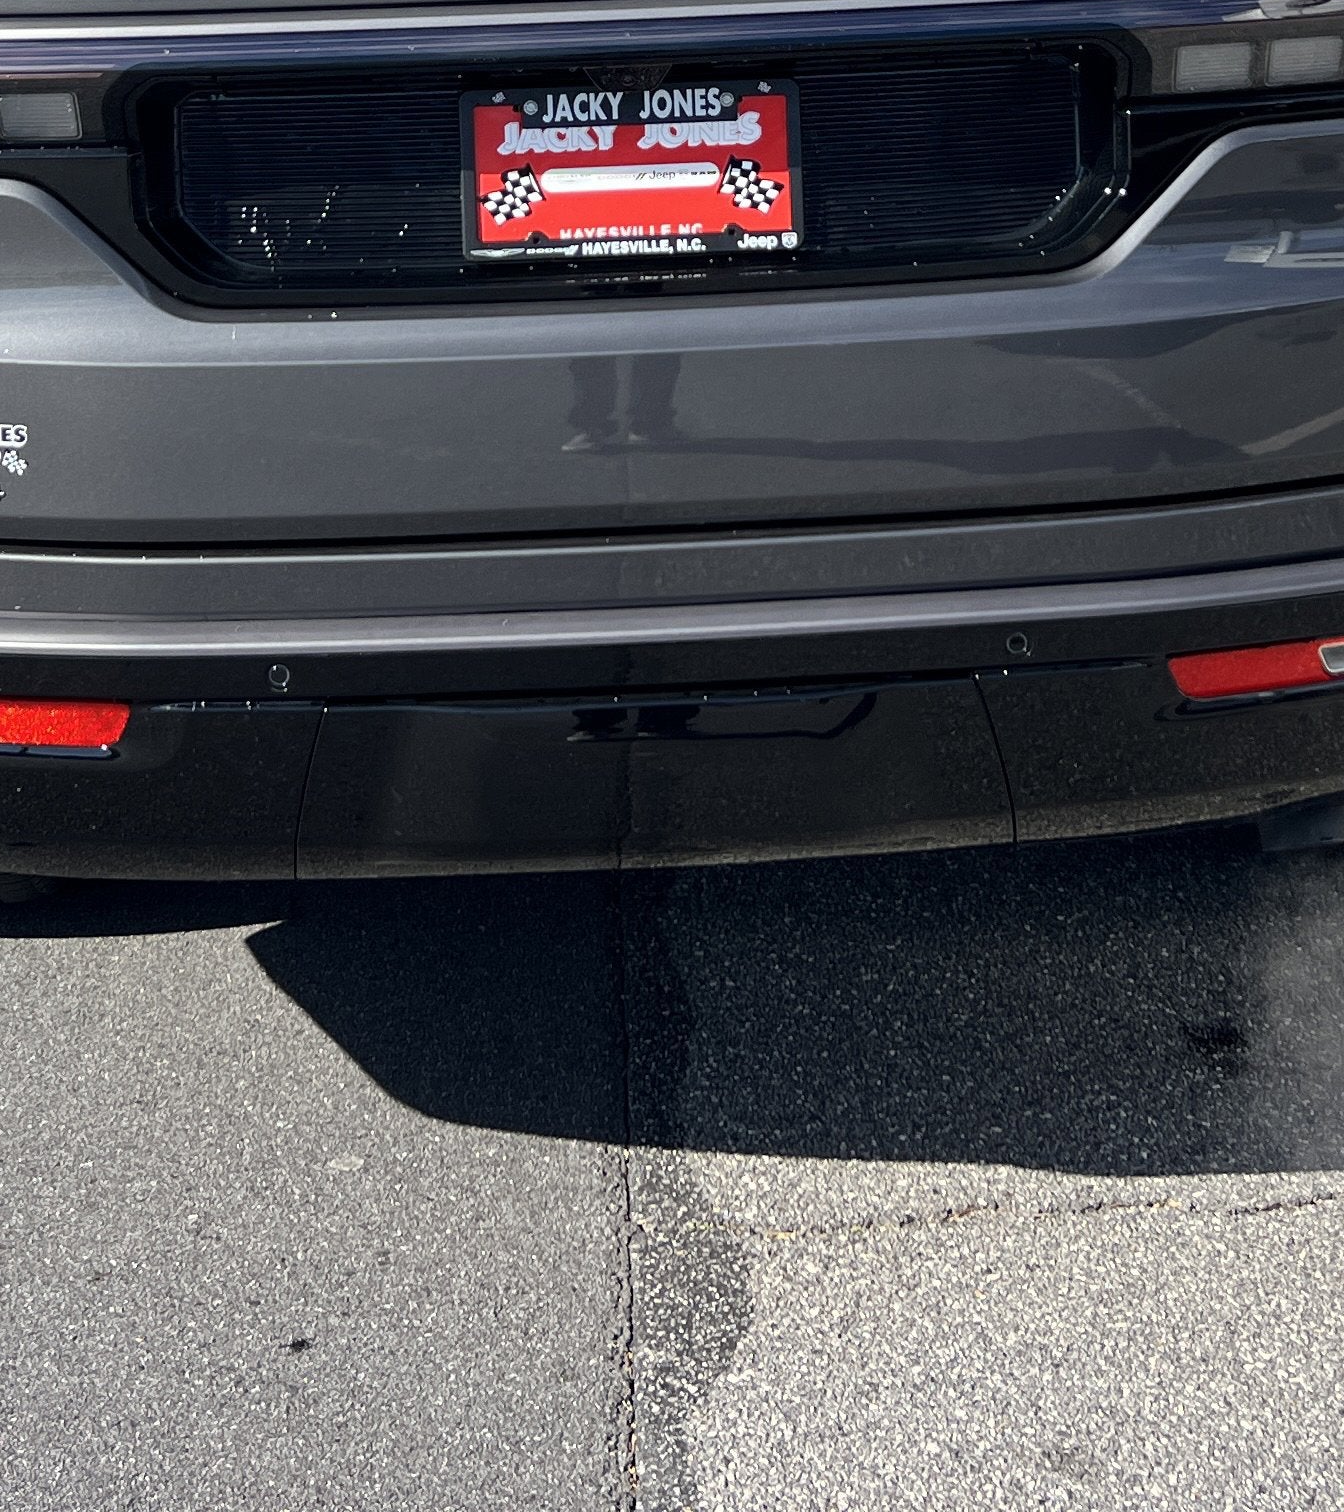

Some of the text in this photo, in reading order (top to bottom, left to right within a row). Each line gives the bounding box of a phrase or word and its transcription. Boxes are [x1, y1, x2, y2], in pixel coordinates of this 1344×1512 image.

[542, 87, 722, 123] JACKY JONES
[497, 110, 762, 155] JACKY JONES
[582, 239, 674, 257] HAYESVILLE,
[676, 238, 707, 253] N.C.
[737, 233, 778, 250] Jeep
